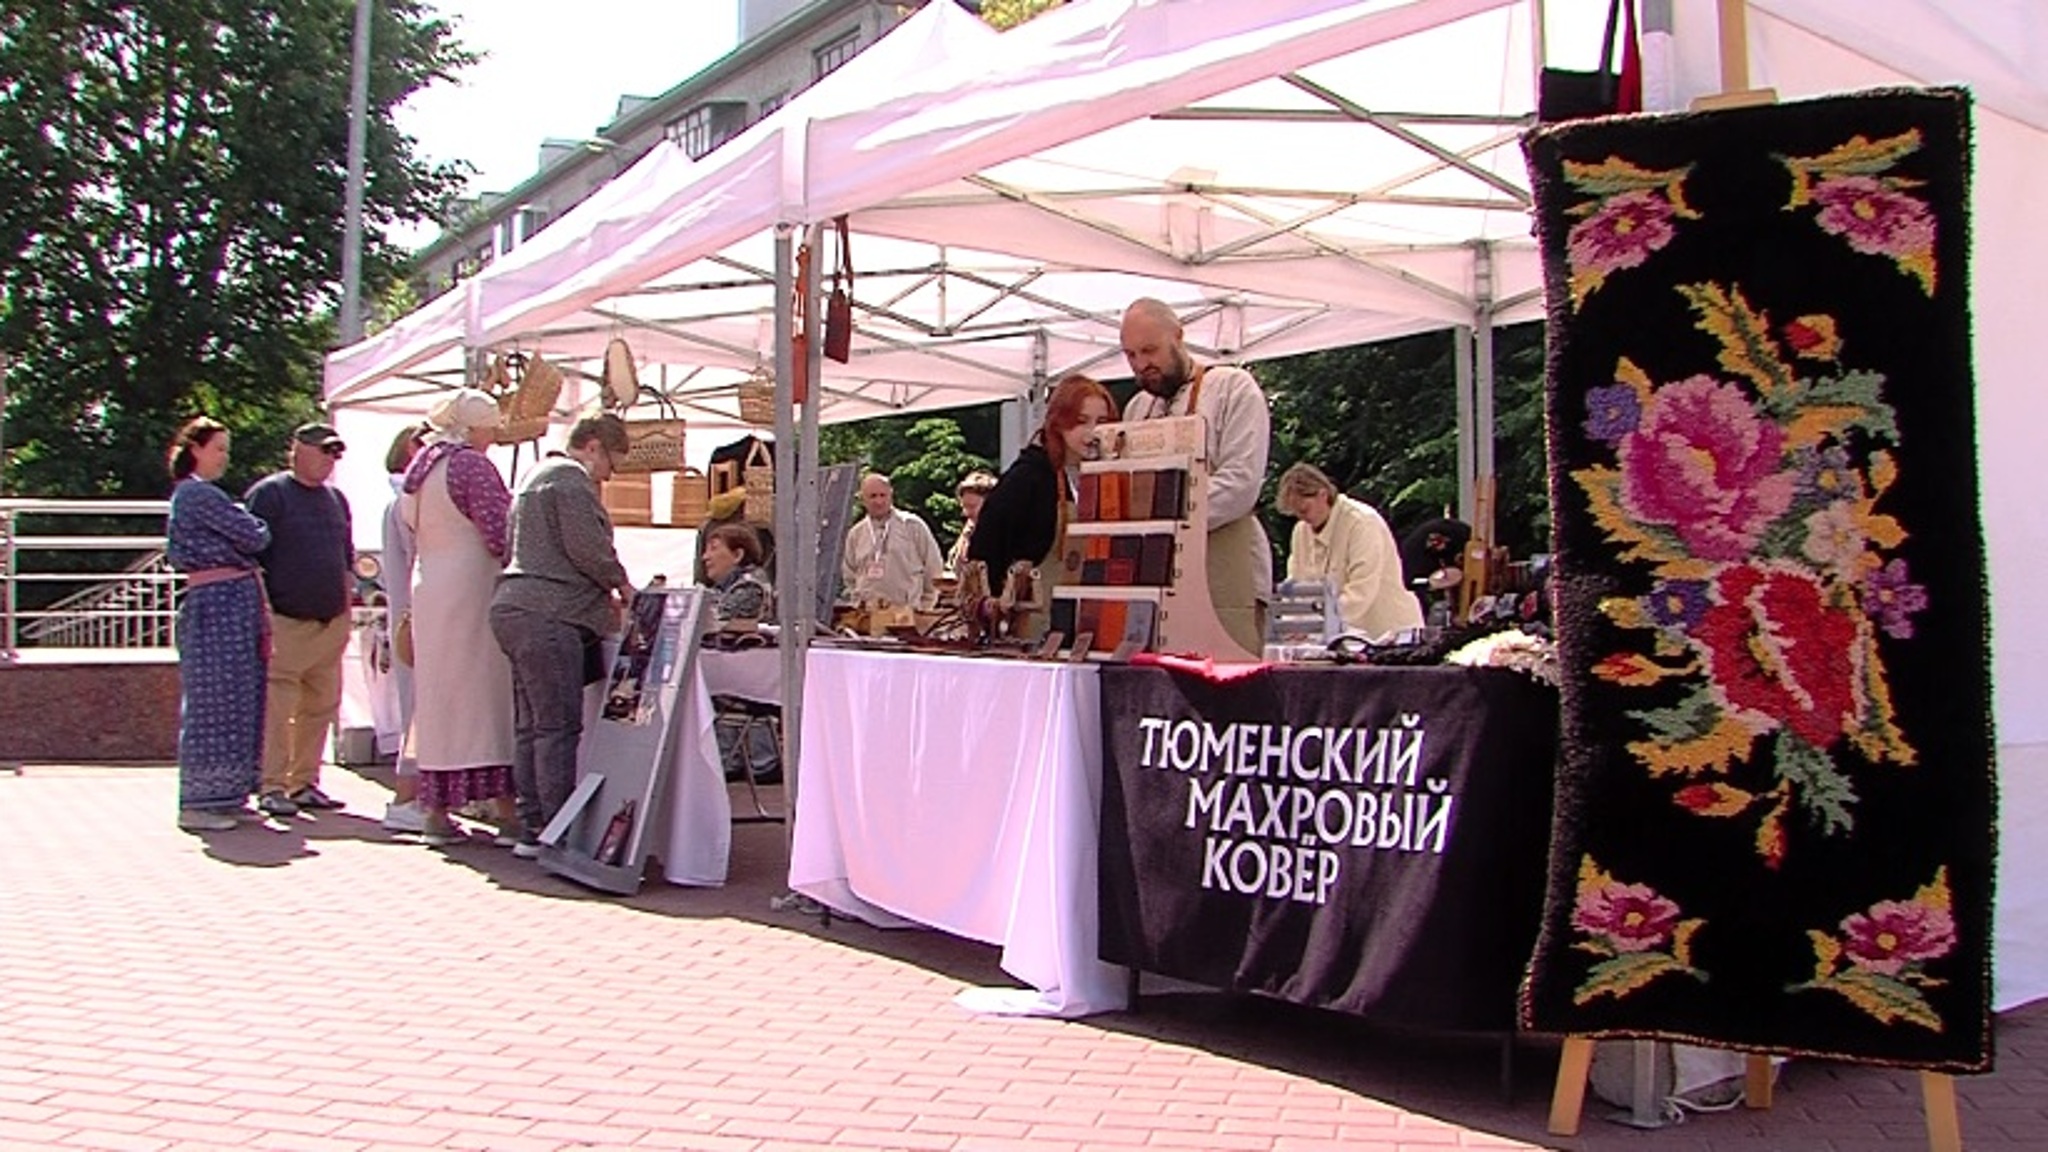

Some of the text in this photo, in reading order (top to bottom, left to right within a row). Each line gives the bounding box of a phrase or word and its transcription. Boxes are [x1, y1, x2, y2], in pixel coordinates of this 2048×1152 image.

[1138, 713, 1425, 786] ТЮМЕНСКИЙ
[1184, 777, 1453, 853] МАХРОВЫЙ
[1201, 835, 1340, 904] КОВЁР
